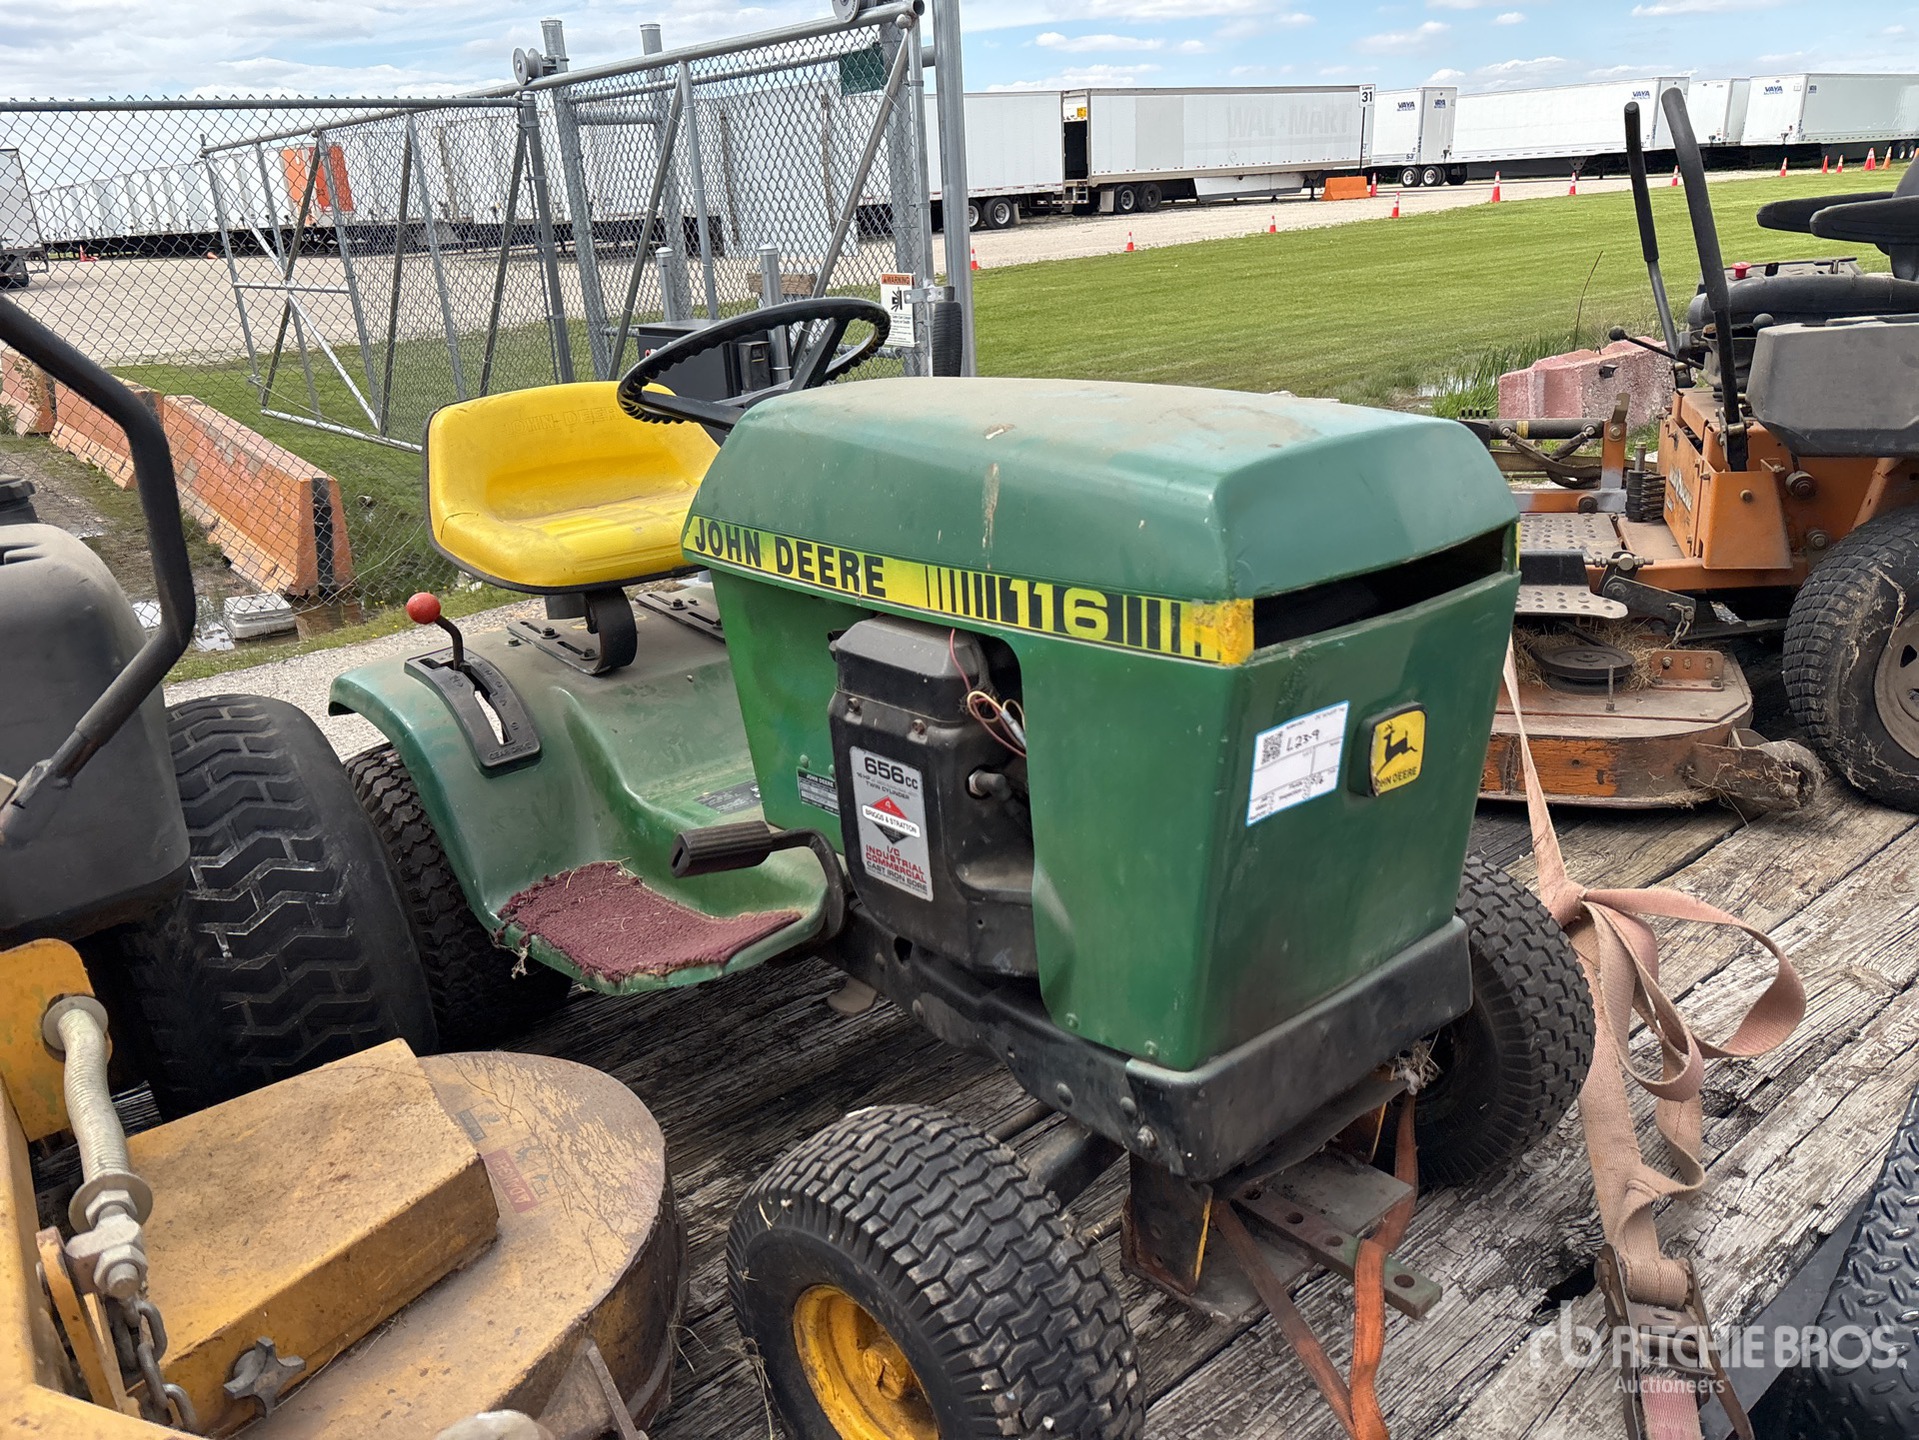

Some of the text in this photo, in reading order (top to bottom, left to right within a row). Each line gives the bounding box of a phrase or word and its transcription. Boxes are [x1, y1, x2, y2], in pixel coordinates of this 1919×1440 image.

[1361, 91, 1372, 102] 31
[694, 518, 886, 598] JOHN DEERE
[1009, 578, 1109, 641] 116
[1393, 767, 1418, 784] DEERE
[866, 780, 881, 790] TWIN
[882, 786, 910, 800] CYLINDER
[865, 808, 885, 822] BRIGGS
[889, 818, 918, 834] STRATTON
[865, 844, 925, 875] INDUSTRIAL
[865, 852, 927, 884] COMMERCIAL
[866, 861, 885, 873] CAST
[887, 868, 906, 882] IRON
